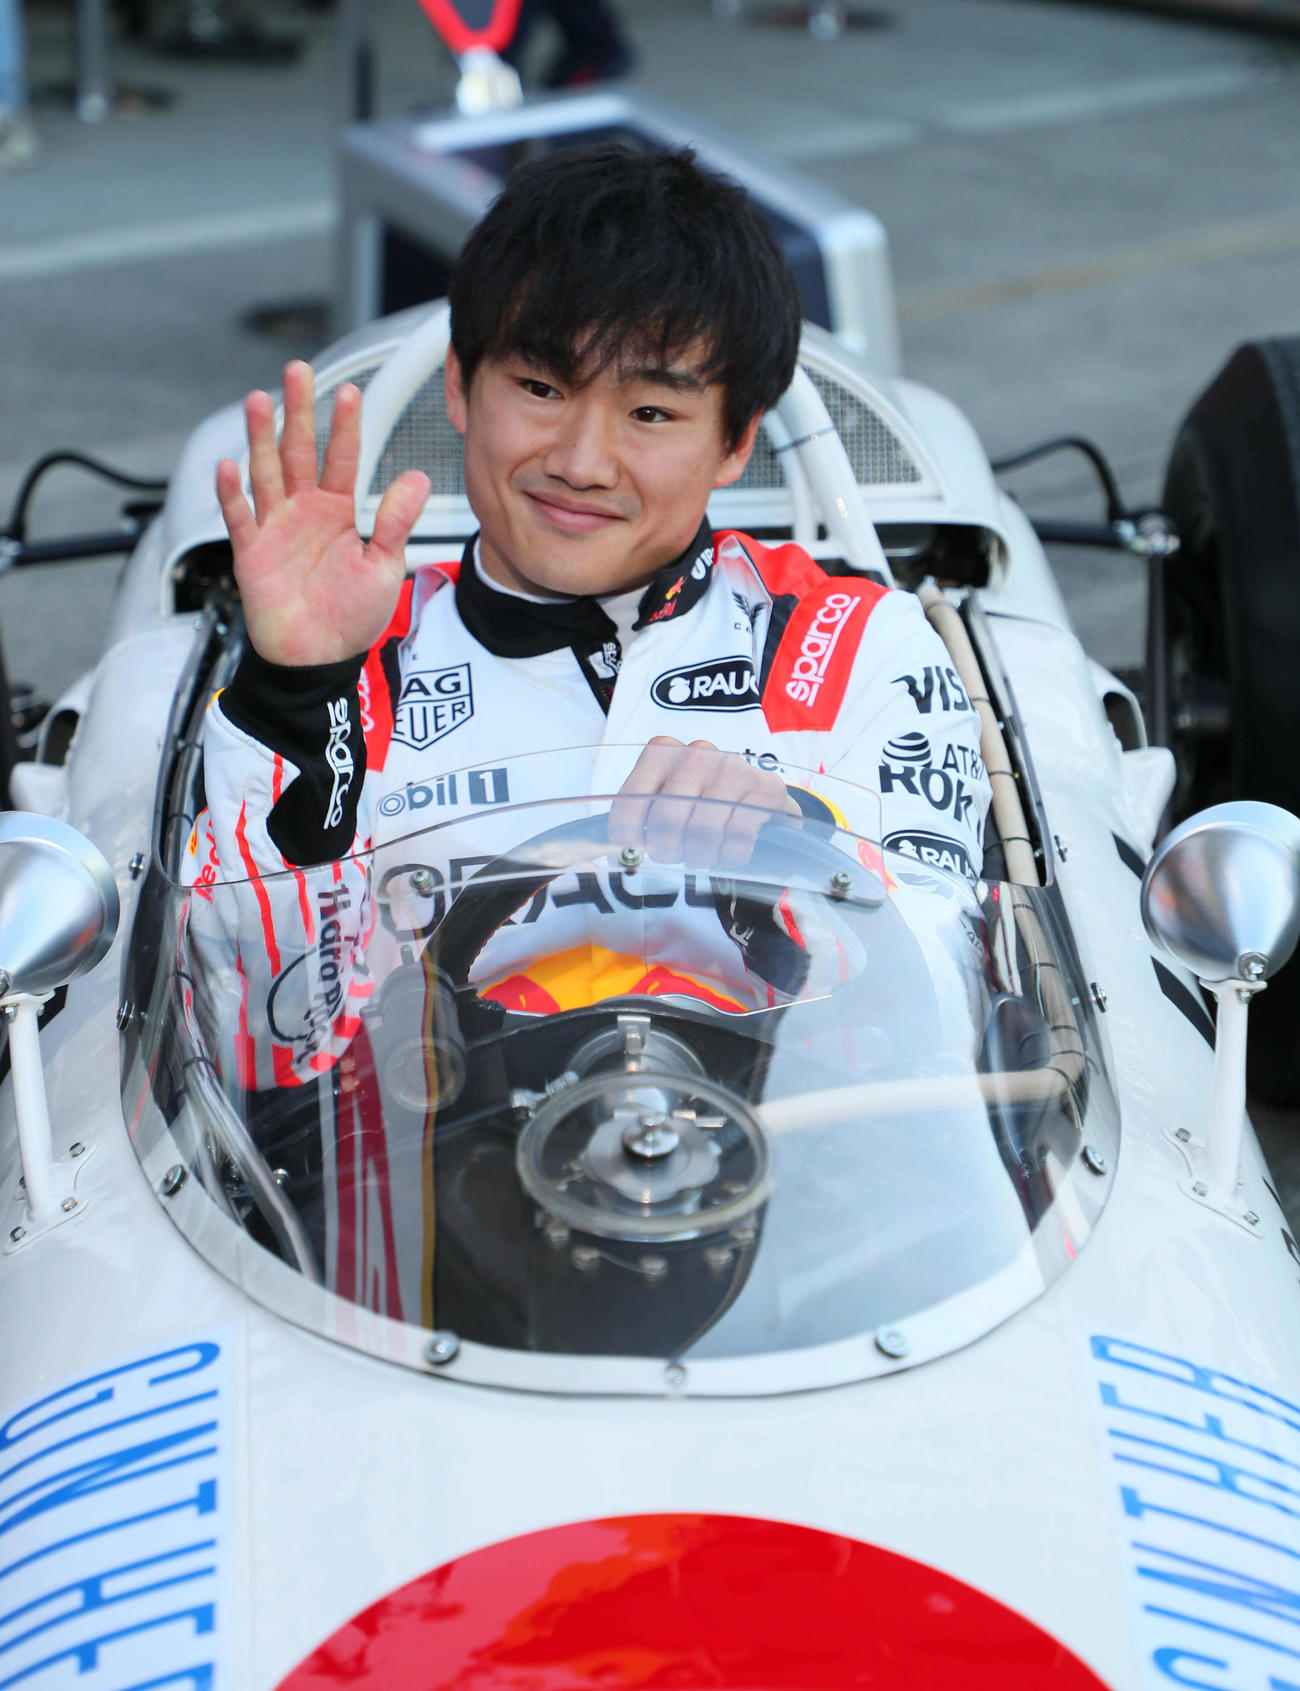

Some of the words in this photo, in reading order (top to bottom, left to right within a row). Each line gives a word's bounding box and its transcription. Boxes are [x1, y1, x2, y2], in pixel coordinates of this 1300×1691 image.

[785, 593, 861, 707] sparco
[401, 672, 462, 699] AG
[890, 665, 976, 713] VIS
[394, 701, 467, 743] EUER
[323, 697, 355, 830] sparco
[942, 743, 984, 781] AT&
[379, 773, 459, 817] obil
[878, 765, 983, 846] ROK
